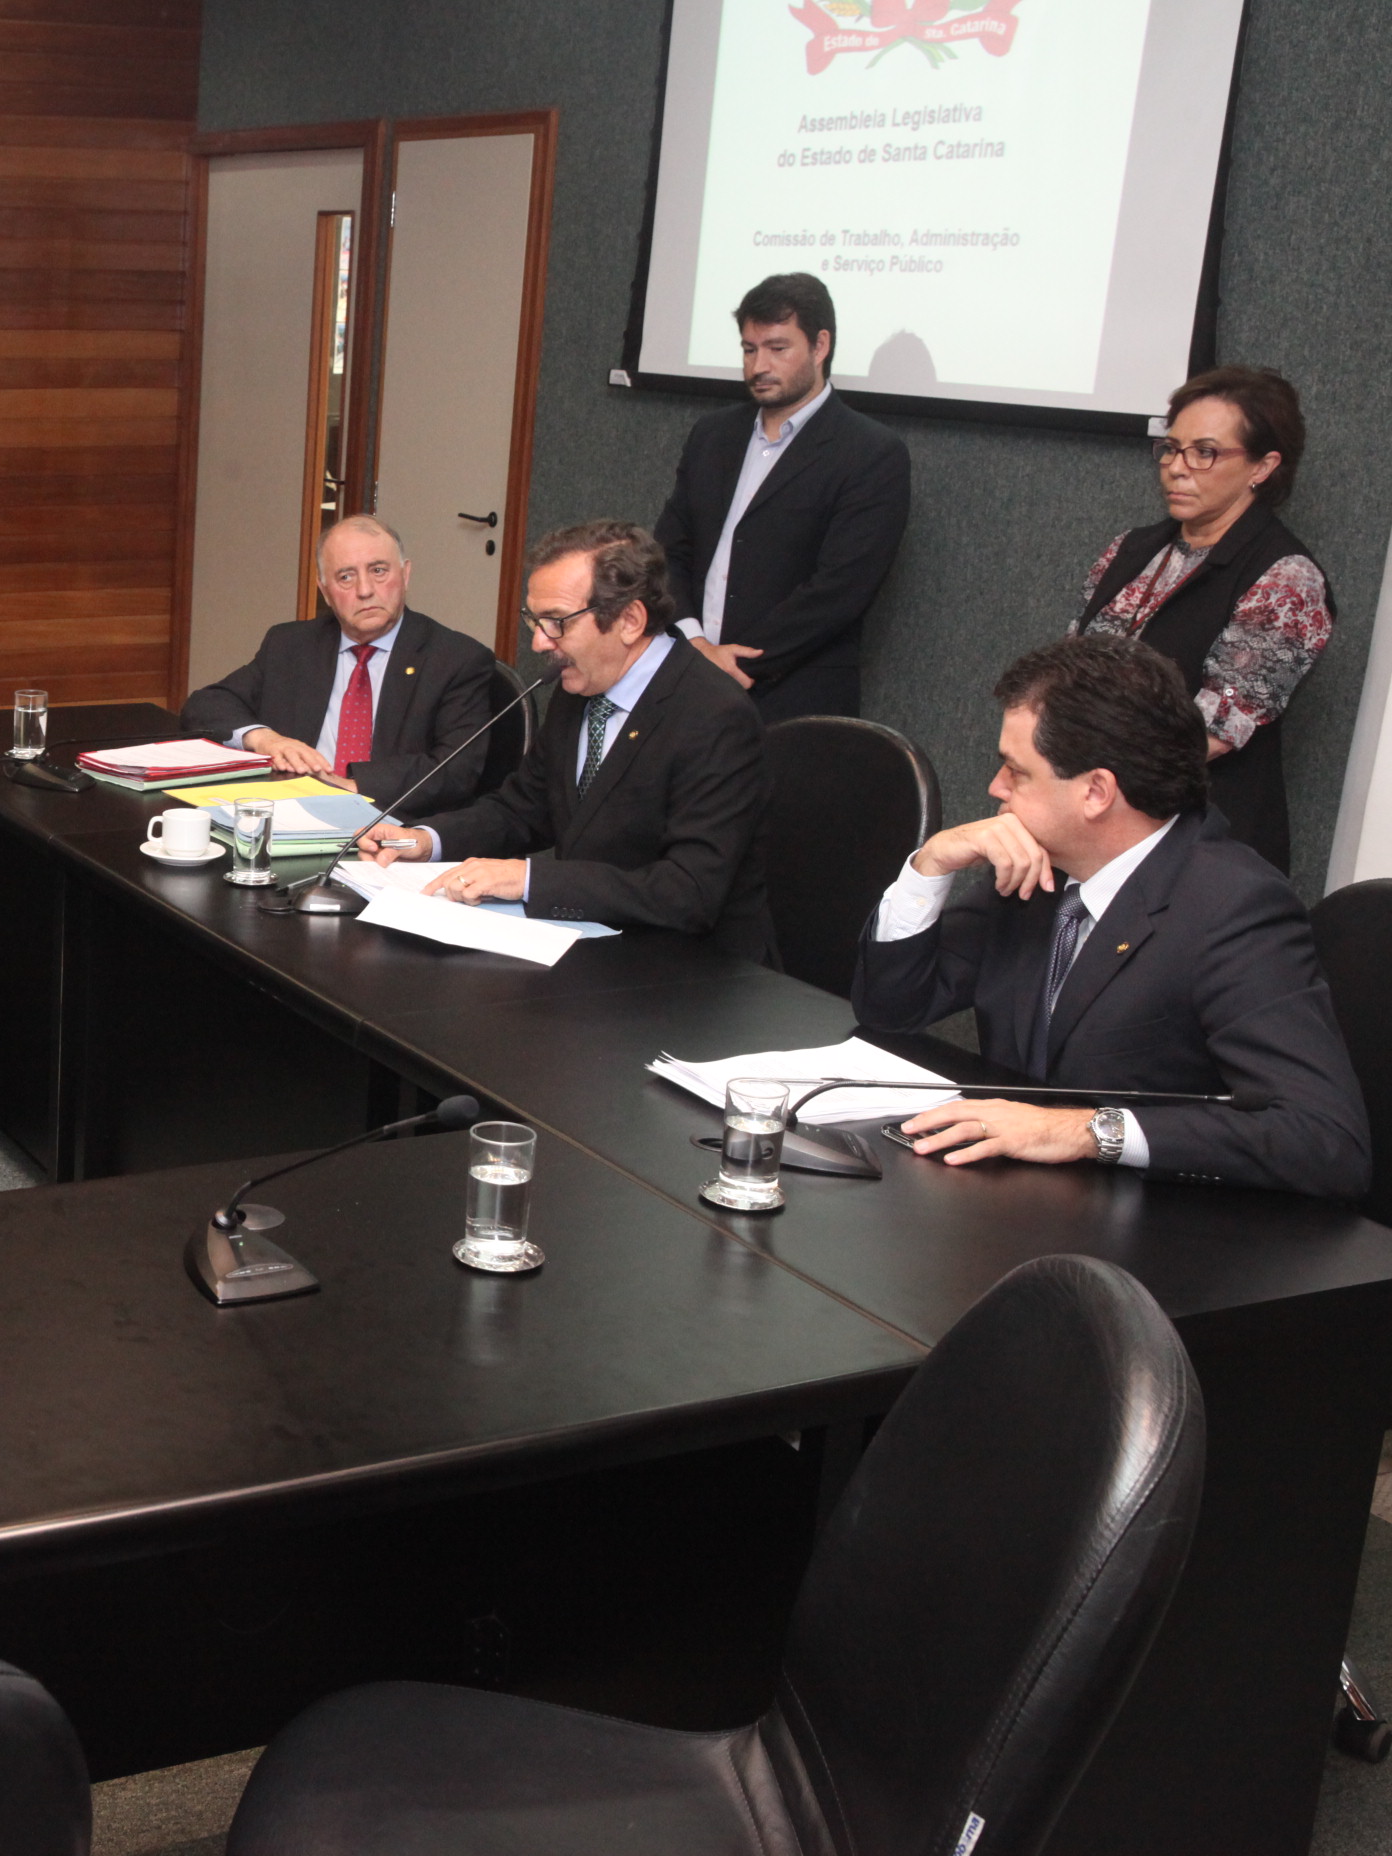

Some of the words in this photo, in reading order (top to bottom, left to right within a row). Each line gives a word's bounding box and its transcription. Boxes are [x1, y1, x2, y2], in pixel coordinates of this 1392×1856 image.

[823, 35, 862, 51] Estado
[950, 17, 1006, 36] Catarina
[798, 107, 886, 133] Assembleia
[892, 103, 983, 131] Legislativa
[777, 148, 796, 168] do
[800, 144, 853, 167] Estado
[857, 144, 877, 163] de
[881, 142, 927, 163] Santa
[933, 138, 1006, 160] Catarina
[753, 229, 816, 247] Comissão
[819, 230, 836, 246] de
[841, 229, 905, 249] Trabalho,
[908, 228, 1020, 251] Administração
[821, 258, 829, 271] e
[833, 255, 885, 276] Serviço
[889, 254, 944, 273] Público
